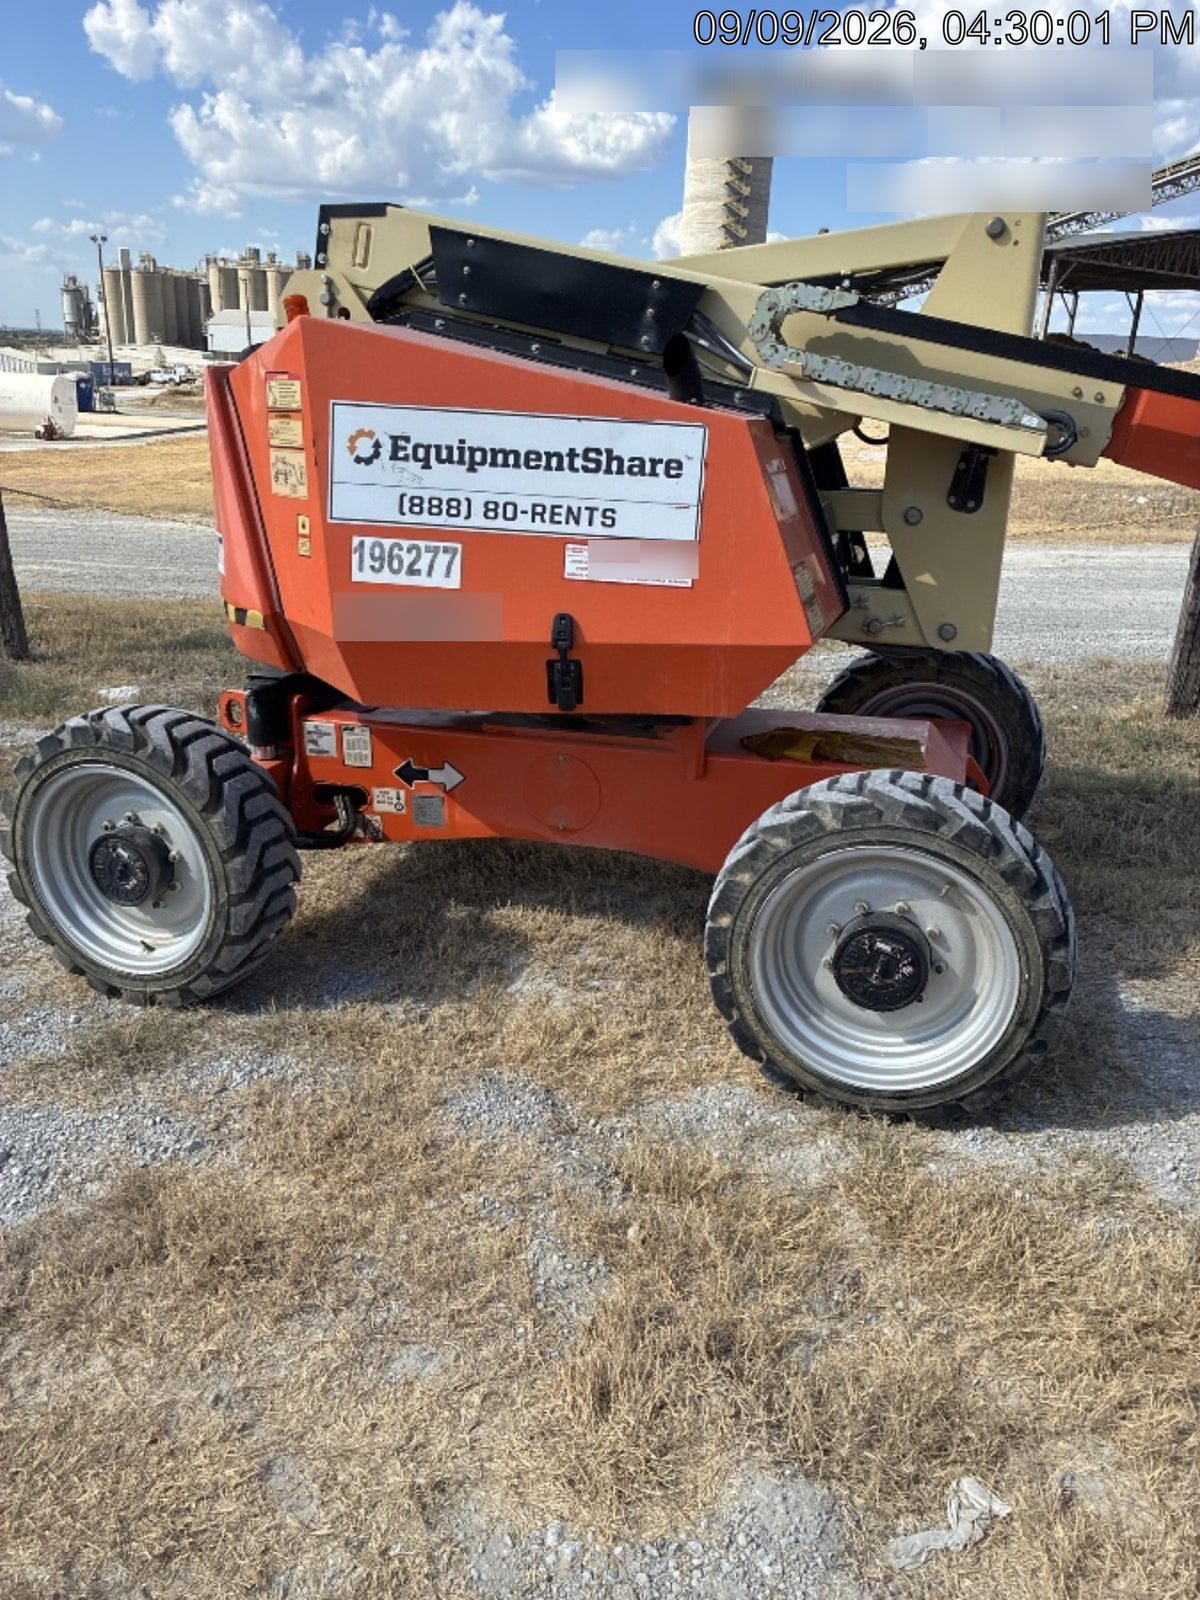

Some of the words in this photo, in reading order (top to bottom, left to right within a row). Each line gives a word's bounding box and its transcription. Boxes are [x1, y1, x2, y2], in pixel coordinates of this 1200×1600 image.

[389, 435, 684, 479] EquipmentShare
[399, 493, 472, 520] (888)
[483, 500, 616, 528] 80-RENTS
[352, 538, 460, 579] 196277
